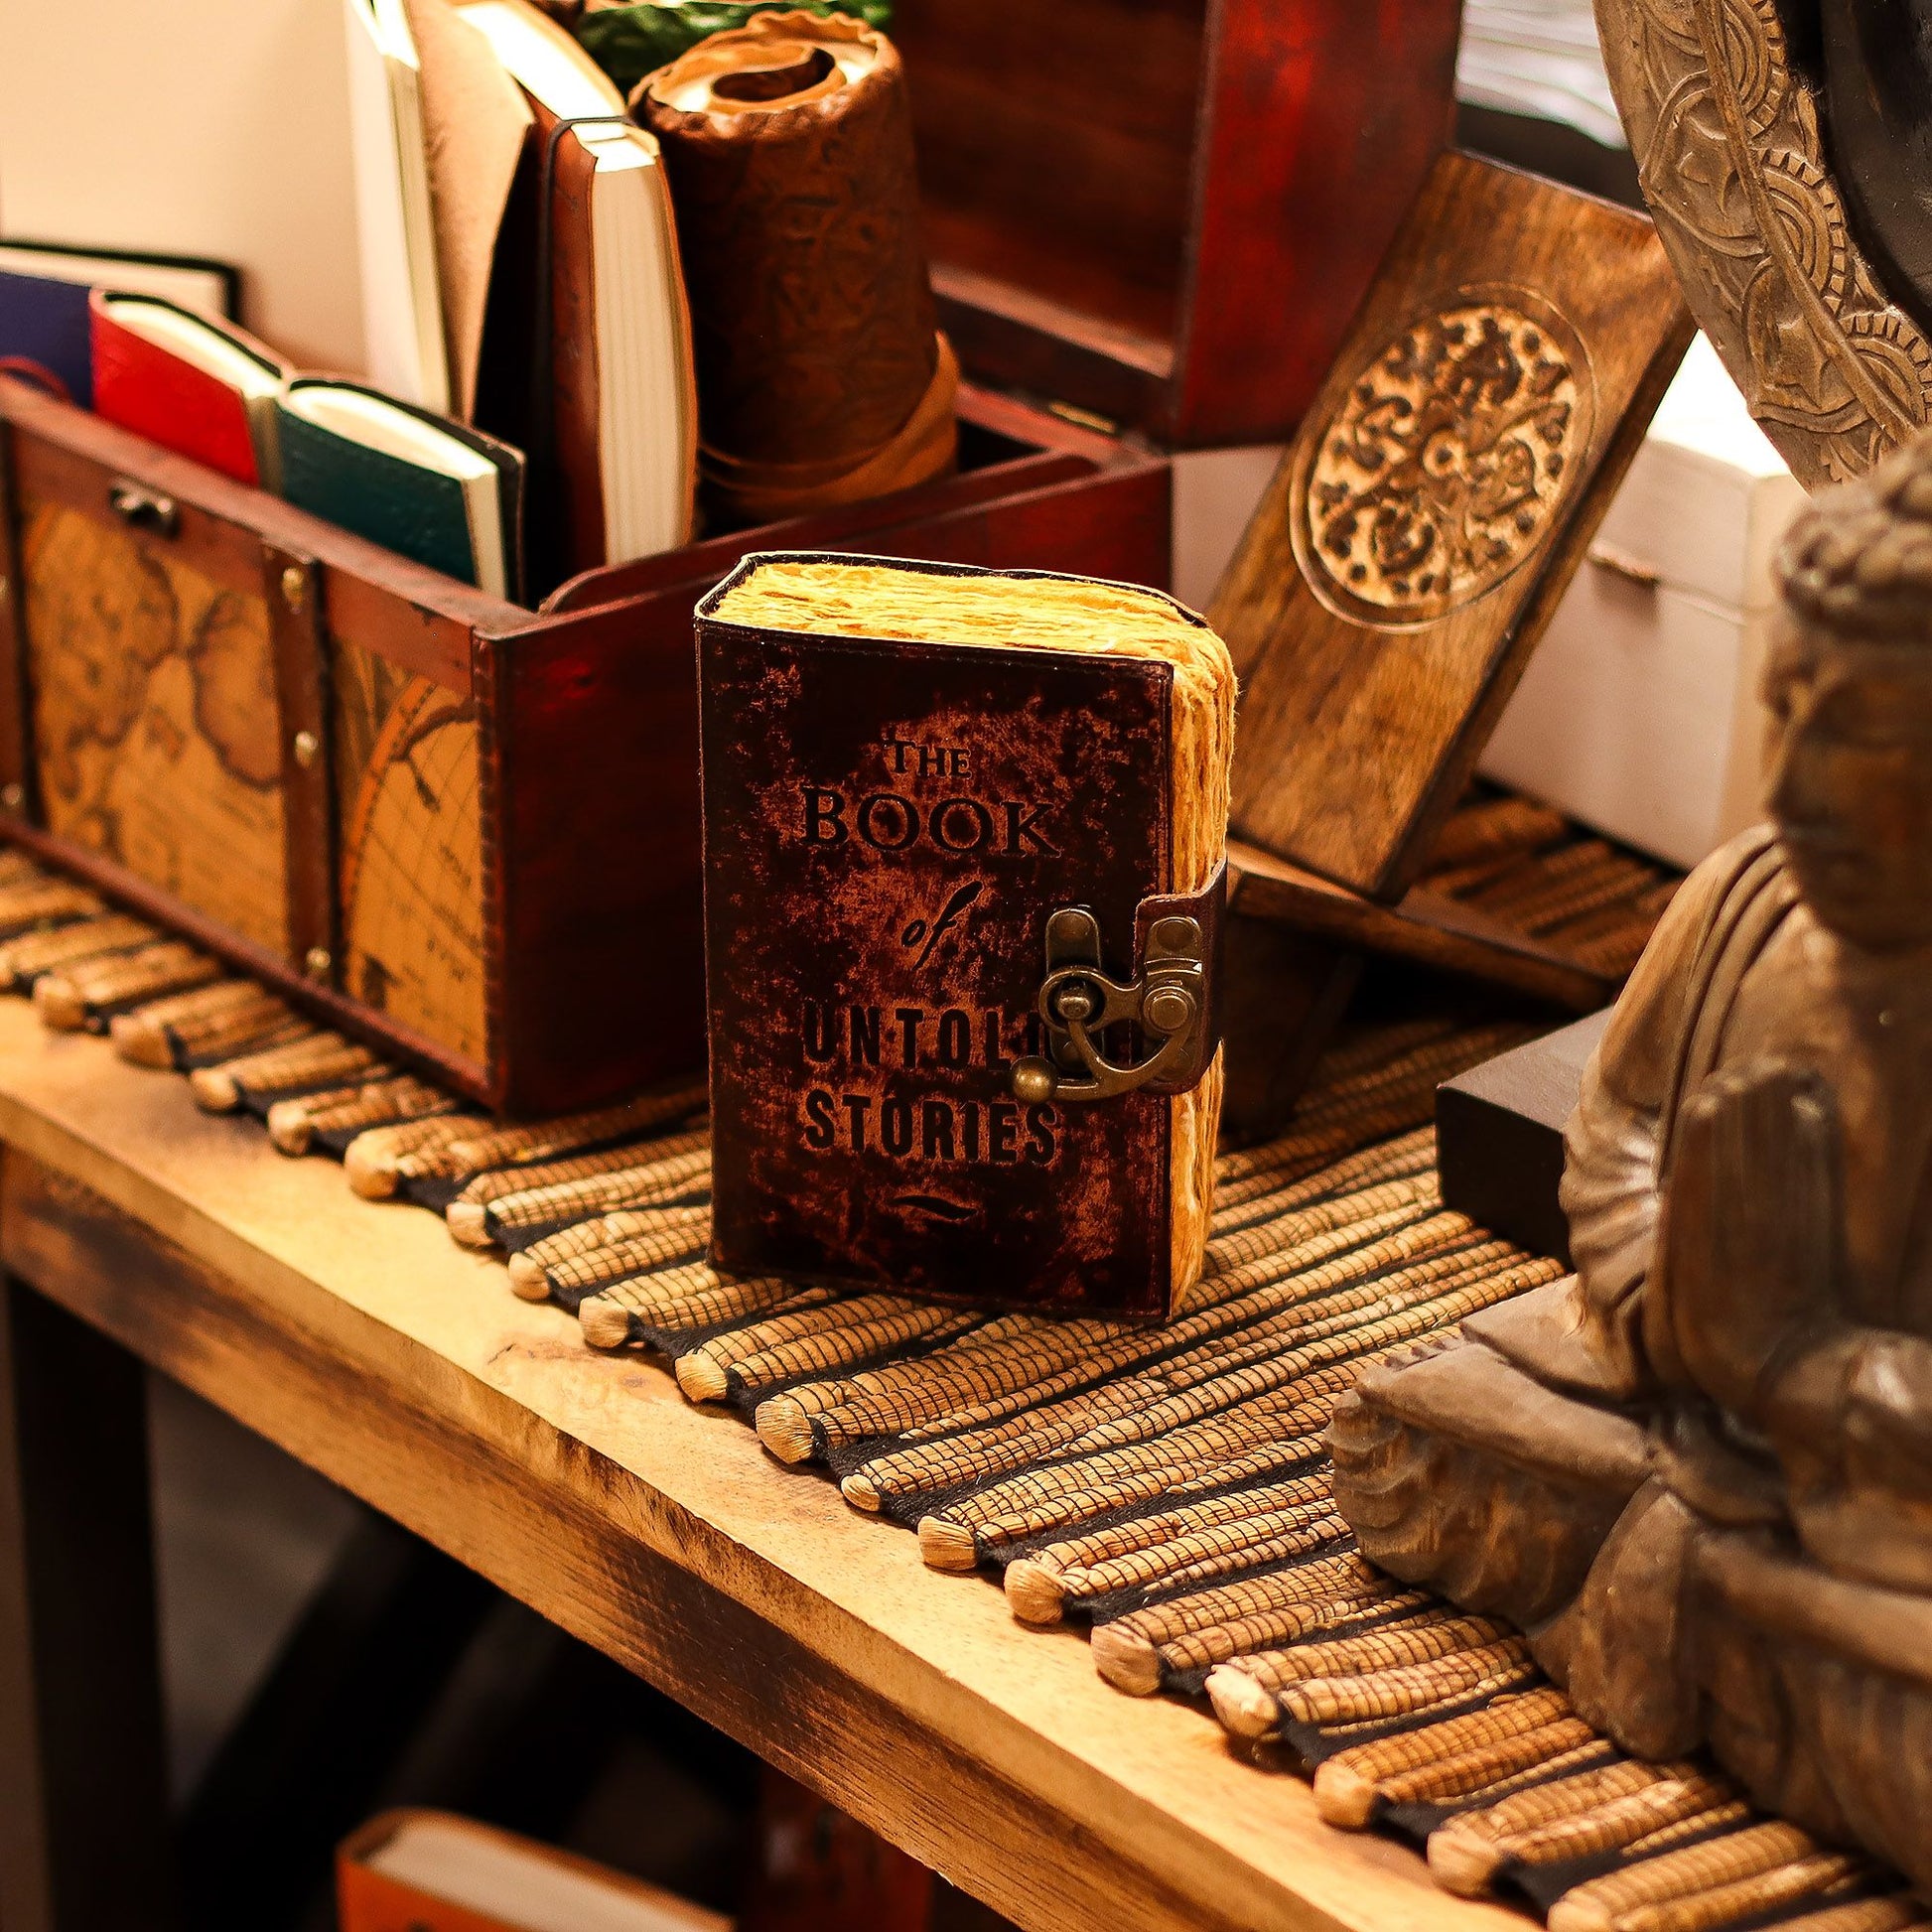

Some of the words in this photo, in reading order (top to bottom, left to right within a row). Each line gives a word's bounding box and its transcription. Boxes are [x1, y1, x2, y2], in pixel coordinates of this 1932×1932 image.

[884, 741, 972, 779] THE
[802, 785, 1062, 859] BOOK
[900, 881, 984, 969] of
[803, 1089, 1061, 1165] STORIES
